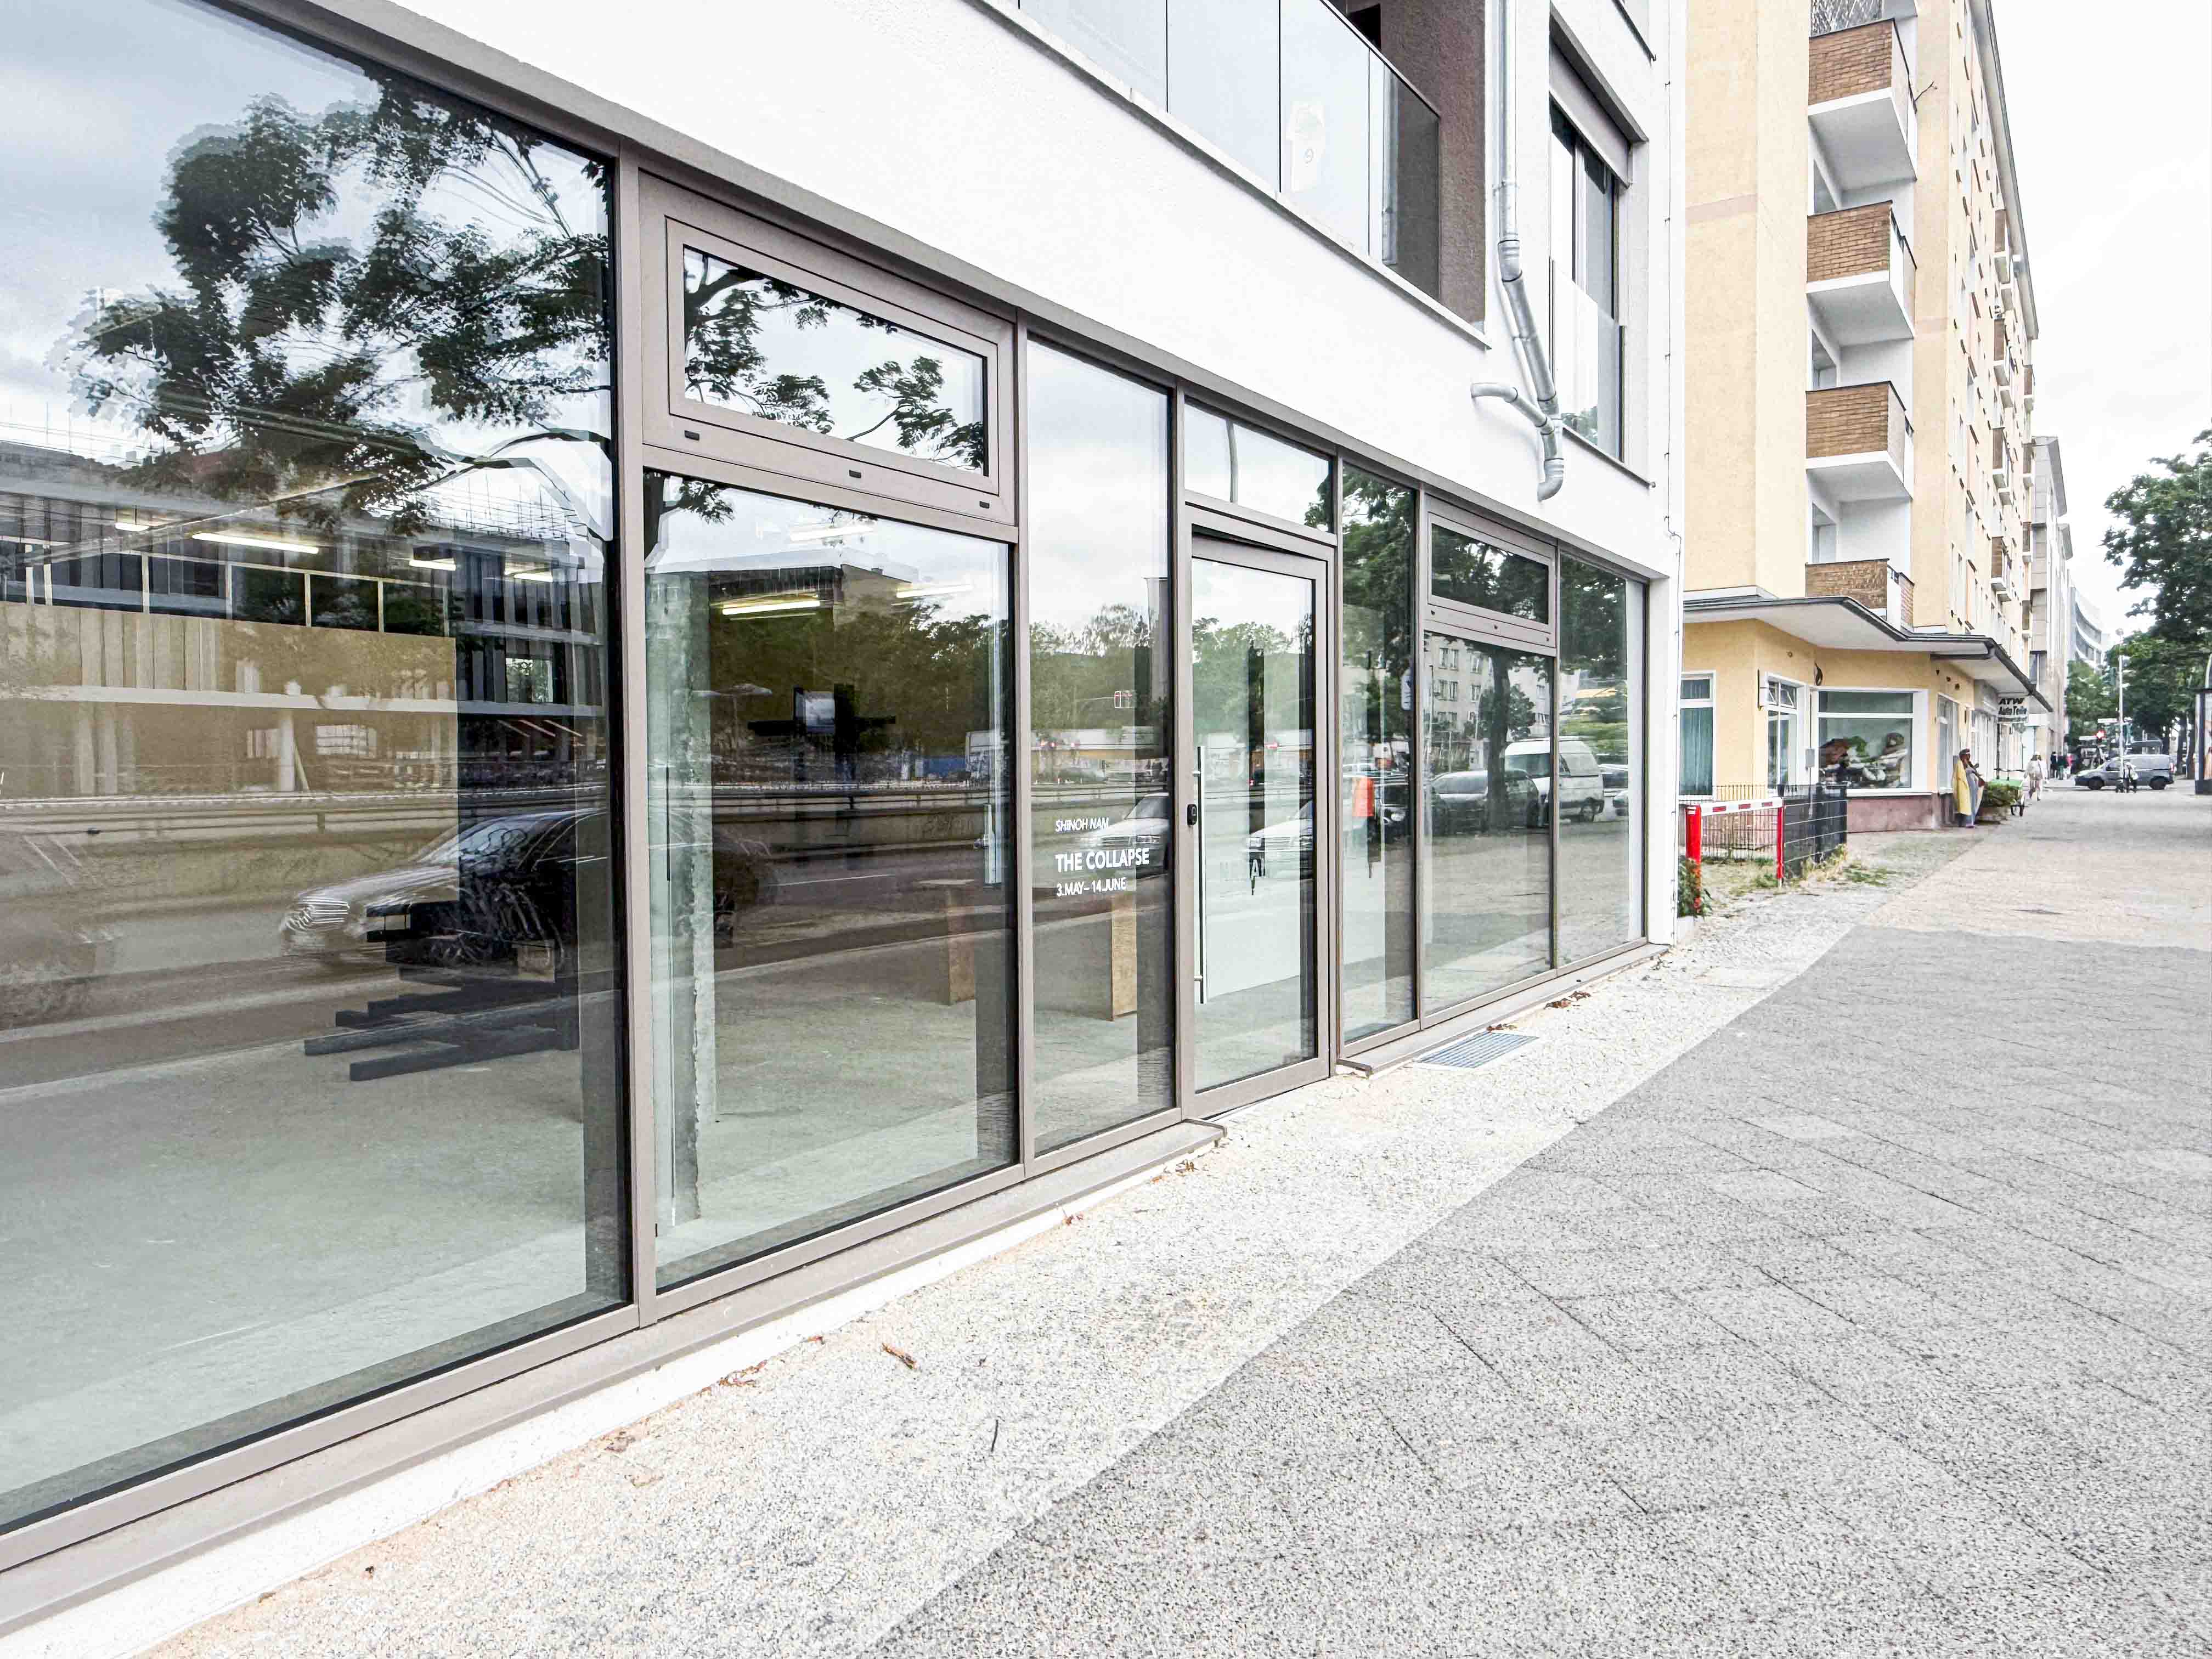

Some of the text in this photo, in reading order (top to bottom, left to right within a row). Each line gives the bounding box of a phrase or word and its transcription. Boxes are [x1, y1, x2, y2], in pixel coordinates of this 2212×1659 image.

[1055, 817, 1109, 832] SHINOH NAM
[1055, 848, 1150, 872] THE COLLAPSE
